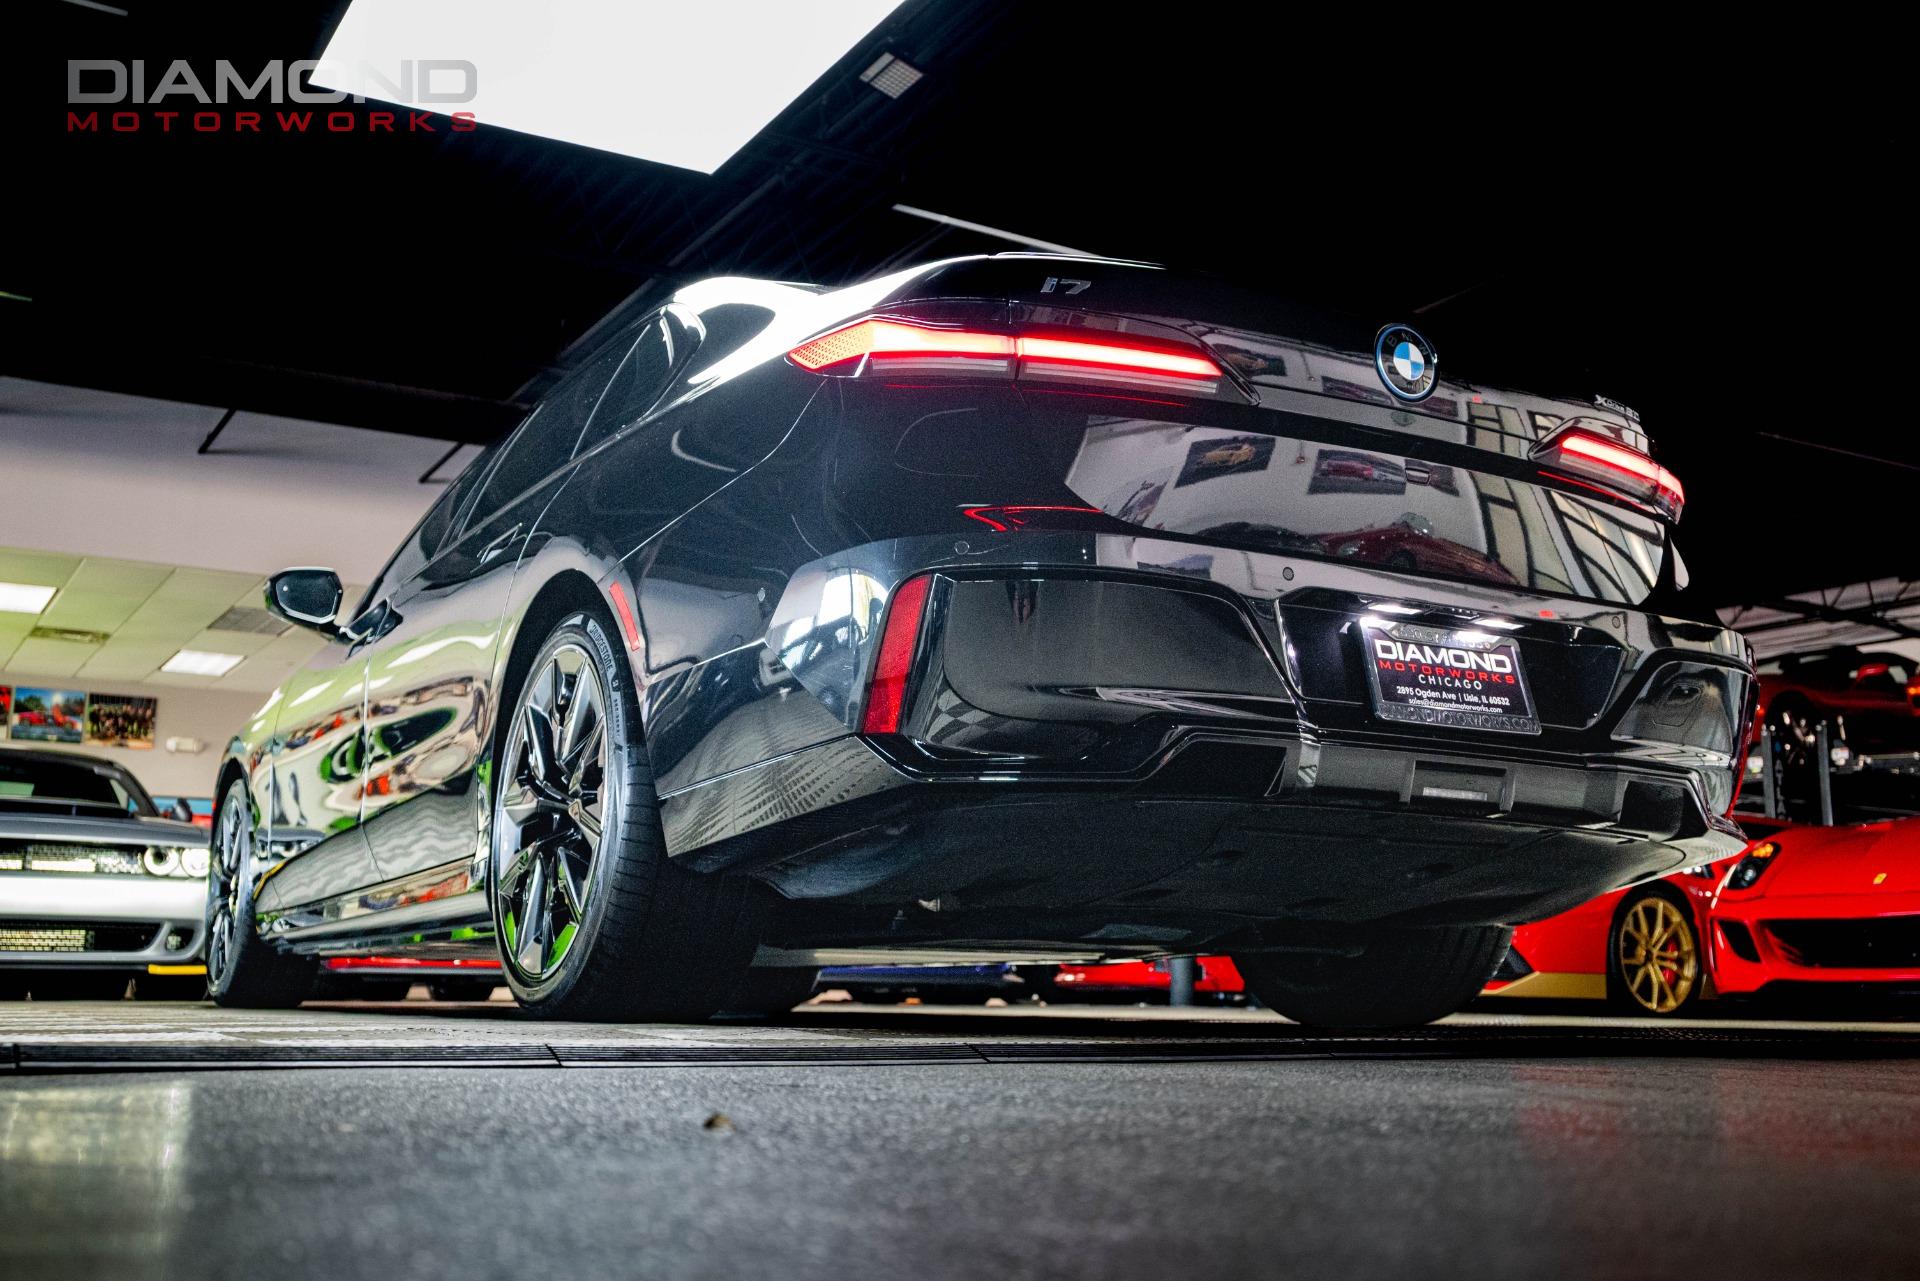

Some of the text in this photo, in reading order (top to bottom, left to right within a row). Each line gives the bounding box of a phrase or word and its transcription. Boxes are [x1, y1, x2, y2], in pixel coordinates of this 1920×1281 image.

[1040, 277, 1091, 294] i7
[1375, 639, 1512, 673] DIAMOND
[1379, 660, 1515, 684] MOTORWORKS
[1418, 674, 1482, 690] CHICAGO
[1396, 686, 1414, 695] 2895
[1415, 688, 1440, 699] Ogden
[1442, 691, 1456, 700] Ave
[1481, 695, 1488, 704] IL
[1489, 696, 1510, 706] 60532
[1408, 698, 1503, 714] sales@diamondmotorworks.com
